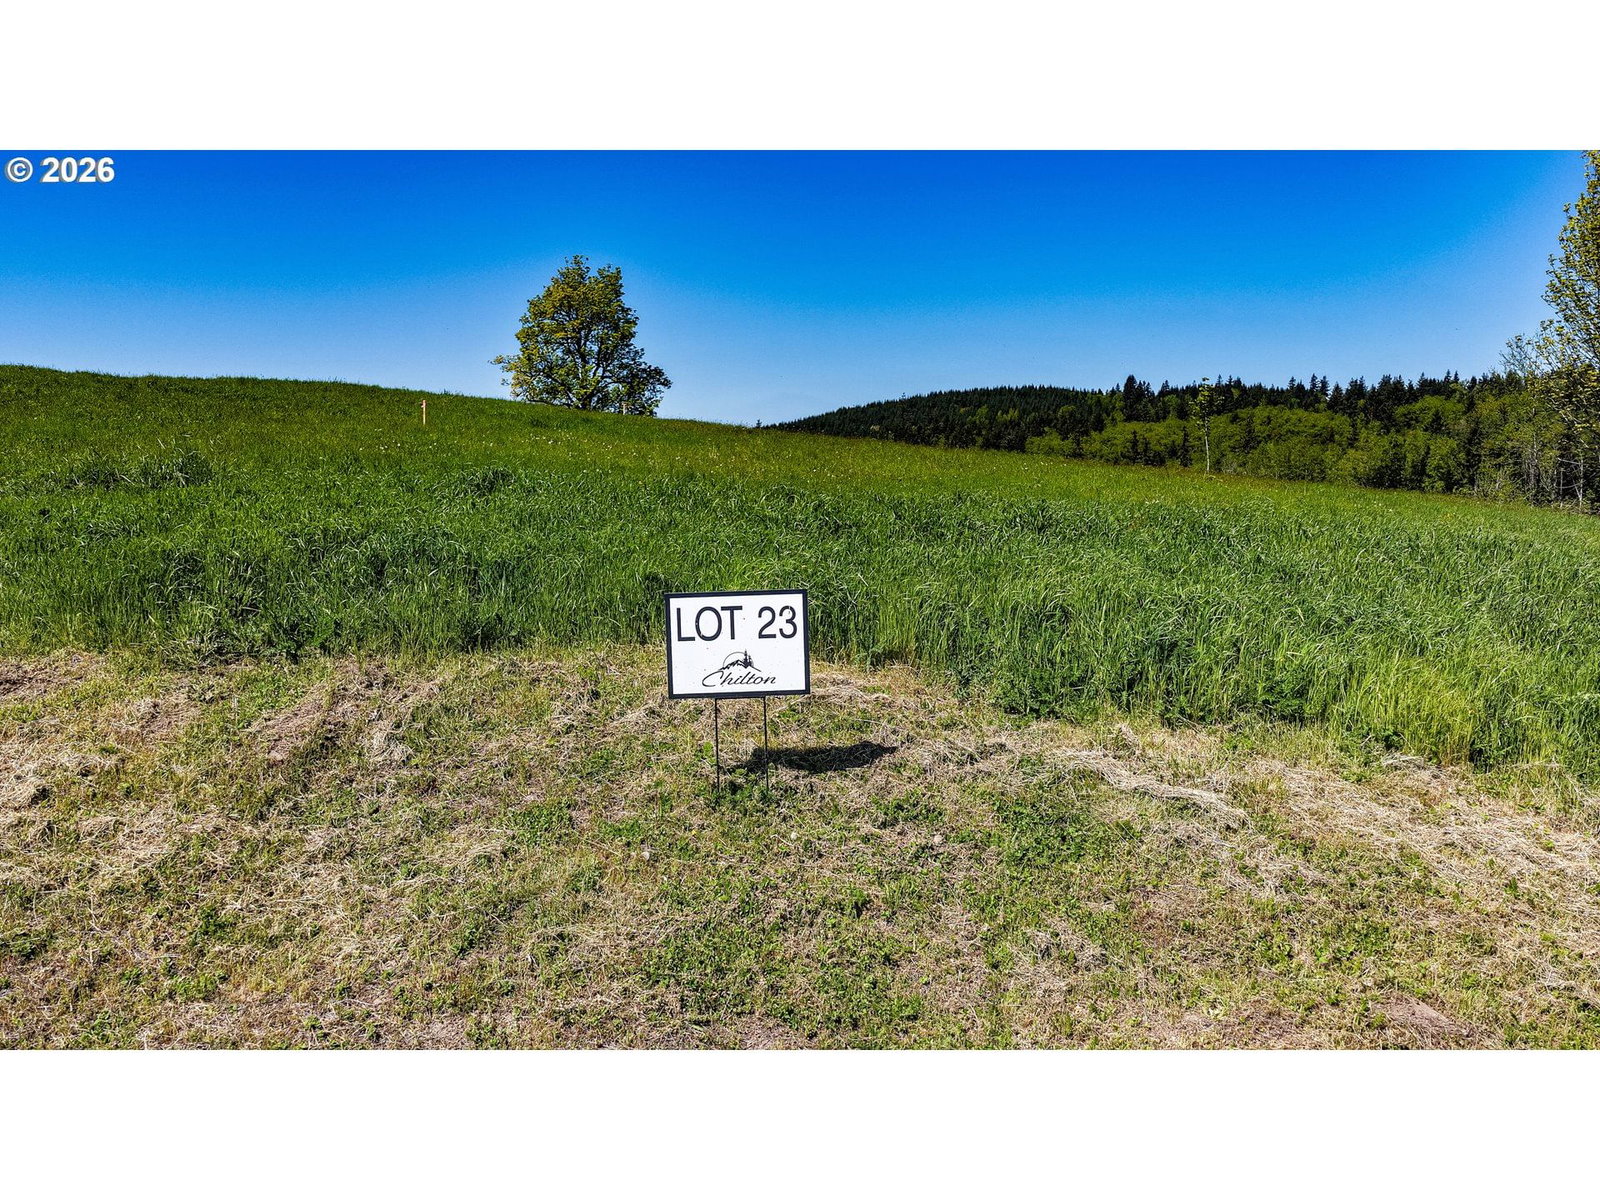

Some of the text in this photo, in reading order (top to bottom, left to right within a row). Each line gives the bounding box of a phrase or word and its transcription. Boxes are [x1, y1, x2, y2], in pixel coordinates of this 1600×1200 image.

[676, 605, 798, 642] LOT 23
[701, 670, 777, 688] Chilton
